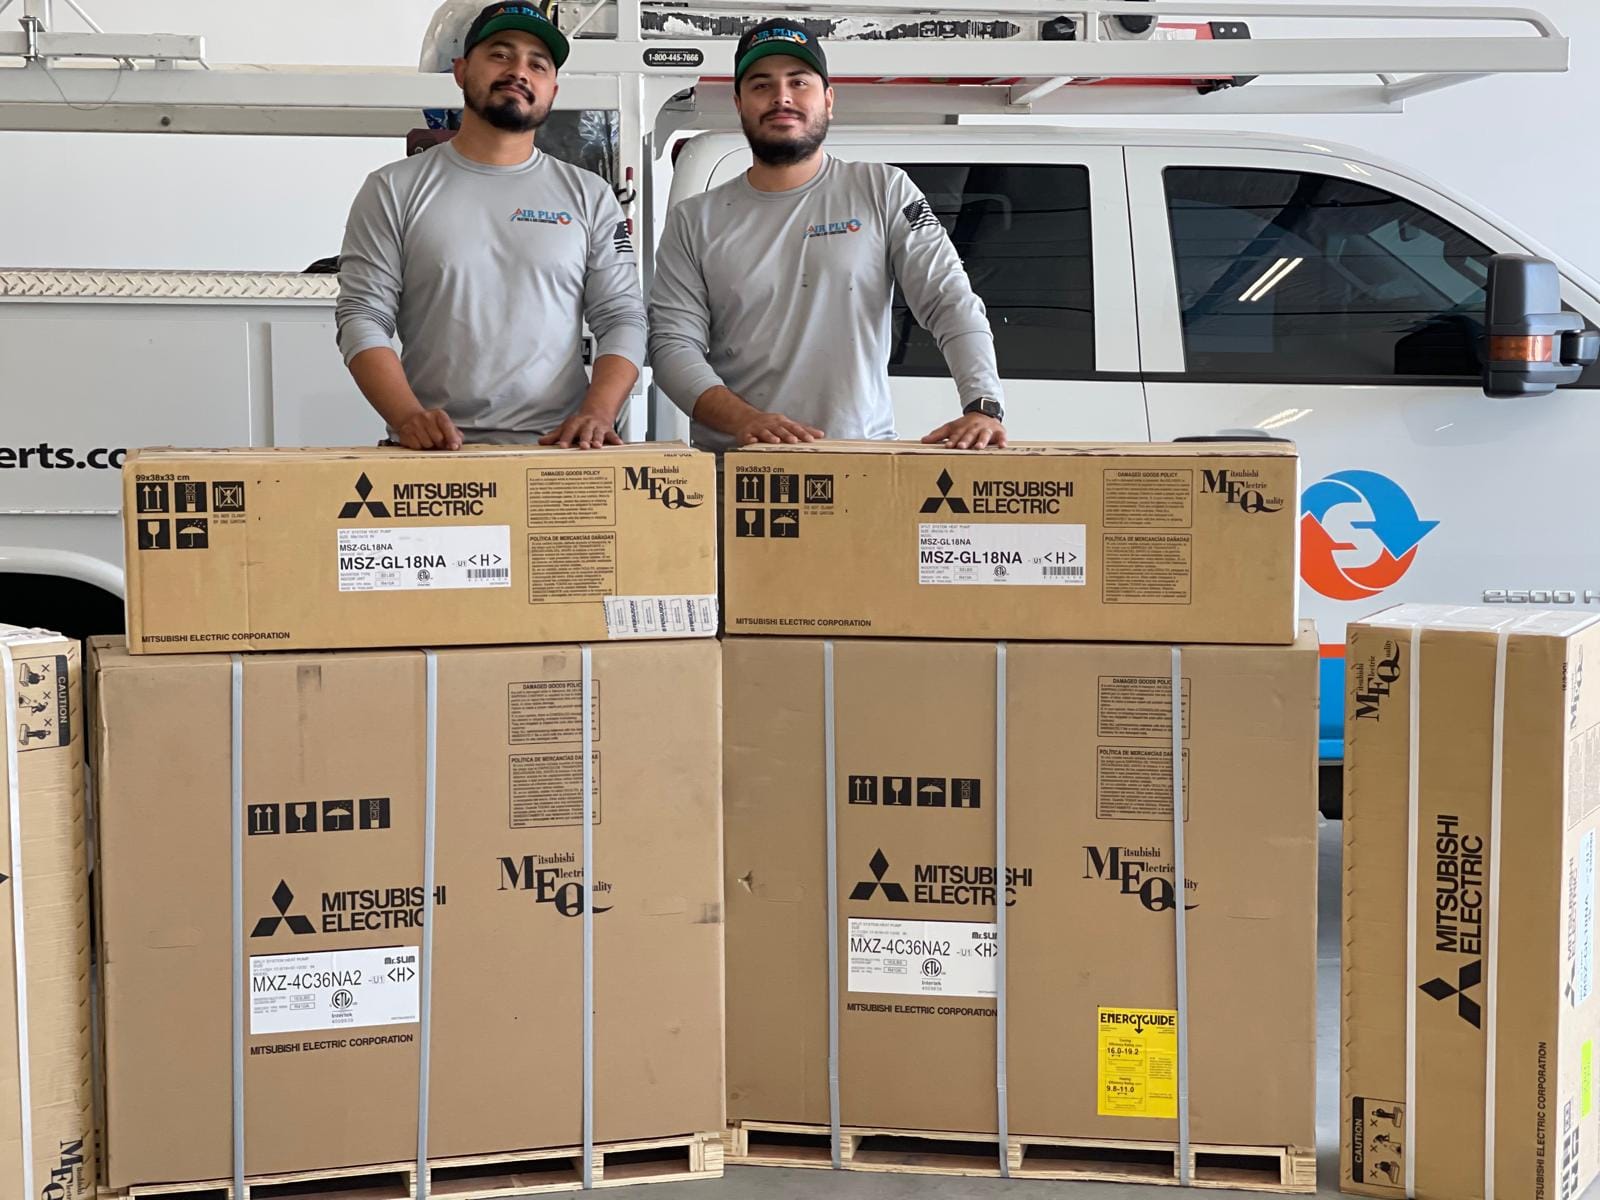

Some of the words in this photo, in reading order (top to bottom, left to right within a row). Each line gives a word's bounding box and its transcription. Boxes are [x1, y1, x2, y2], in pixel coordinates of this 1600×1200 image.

[136, 474, 175, 482] 99x38x33
[393, 482, 497, 500] MITSUBISHI
[973, 481, 1074, 497] MITSUBISHI
[394, 500, 484, 517] ELECTRIC
[973, 499, 1060, 514] ELECTRIC
[340, 544, 393, 552] MSZ-GL18NA
[340, 555, 447, 570] MSZ-GL18NA
[921, 551, 1022, 564] MSZ-GL18NA
[1482, 589, 1576, 604] 2500
[736, 618, 778, 626] MITSUBISHI
[780, 618, 816, 626] ELECTRIC
[141, 634, 188, 643] MITSUBISHI
[190, 633, 230, 642] ELECTRIC
[232, 632, 290, 641] CORPORATION
[58, 676, 68, 724] CAUTION
[1436, 815, 1458, 952] MITSUBISHI
[914, 885, 1017, 907] ELECTRC
[1460, 835, 1483, 955] ELECTRIC
[850, 938, 950, 956] MXZ-4C36NA2
[253, 970, 362, 992] MXZ-4C36NA2
[847, 1003, 892, 1013] MITSUBISHI
[895, 1005, 935, 1014] ELECTRIC
[937, 1007, 997, 1017] CORPORATION
[1100, 1013, 1176, 1026] ENERGYGUIDE
[250, 1043, 300, 1056] MITSUBISHI
[302, 1040, 346, 1052] ELECTRIC
[349, 1034, 413, 1047] CORPORATION
[1107, 1047, 1139, 1055] 16.0-19.2
[1537, 1042, 1547, 1109] CORPORATION
[1354, 1118, 1363, 1163] CAUTION
[1536, 1111, 1546, 1157] ELECTRIC
